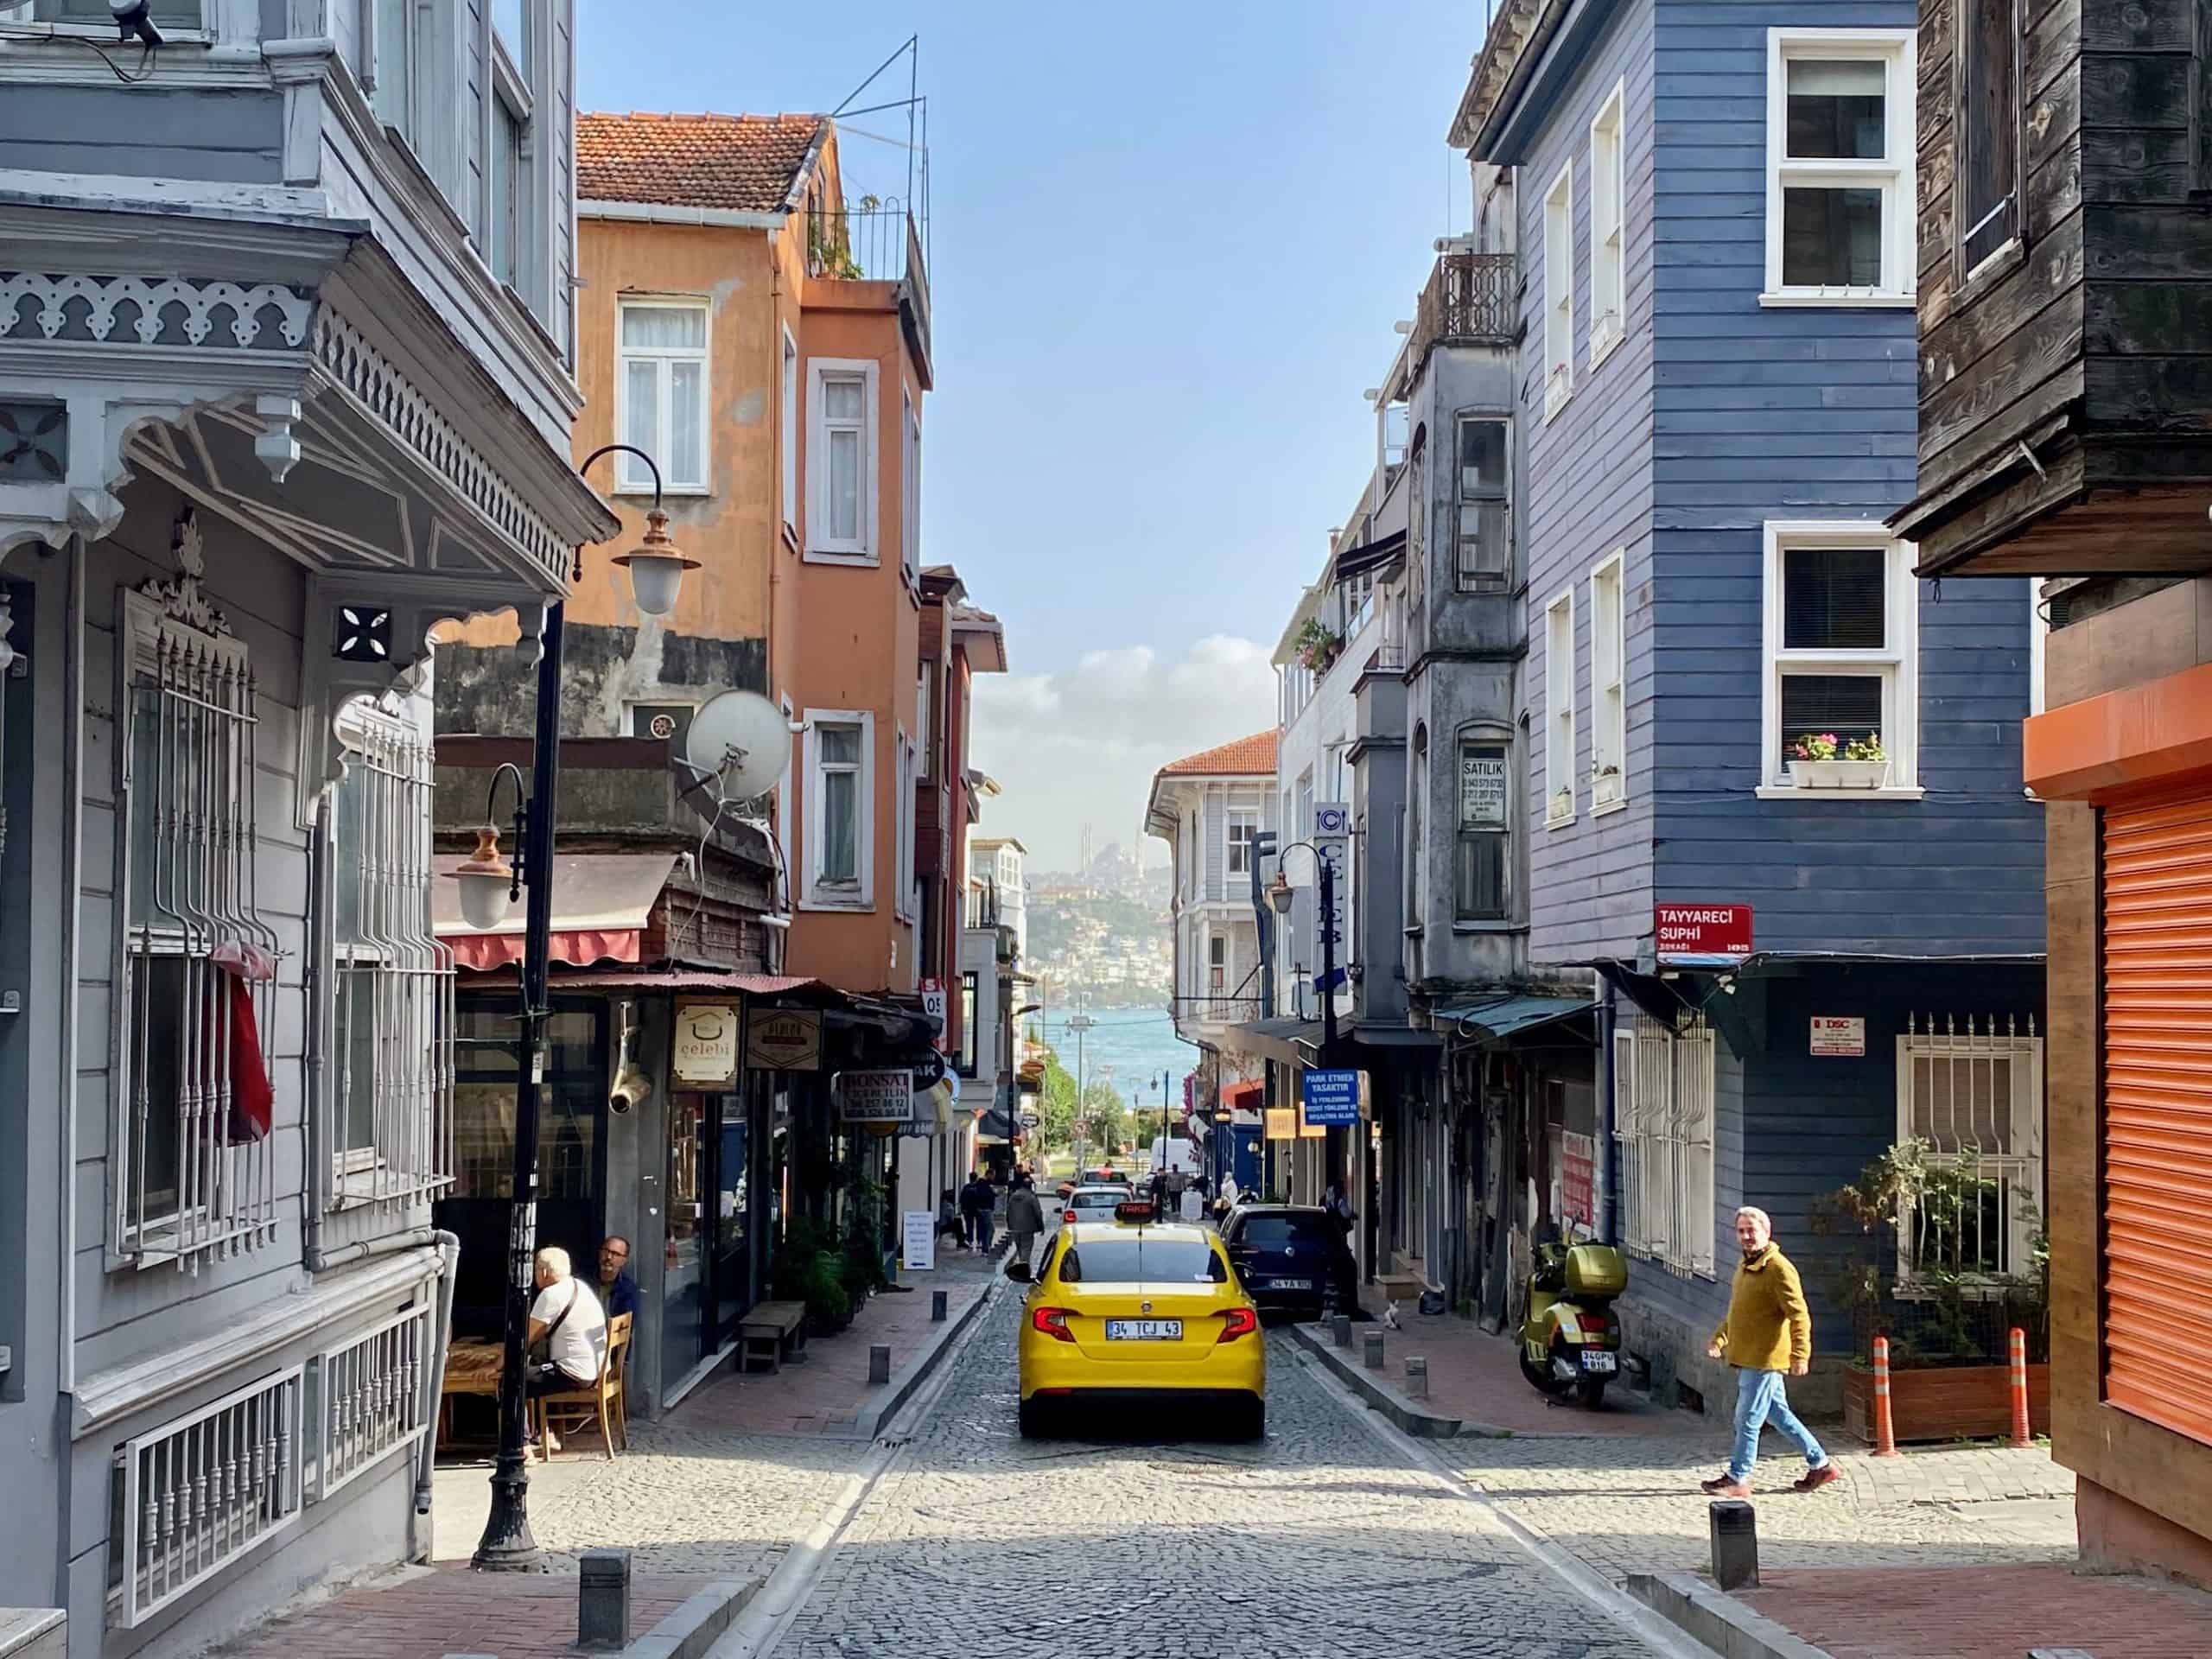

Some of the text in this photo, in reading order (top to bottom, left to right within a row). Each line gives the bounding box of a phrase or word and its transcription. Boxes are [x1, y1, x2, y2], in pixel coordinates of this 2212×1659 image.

[1464, 763, 1503, 775] SATILIK
[1660, 909, 1733, 924] TAYYARECİ
[1660, 925, 1700, 940] SUPHİ
[1826, 1020, 1850, 1029] DSC
[1312, 1084, 1348, 1092] YASAKTIR
[1115, 1323, 1179, 1334] 34 TCJ 43
